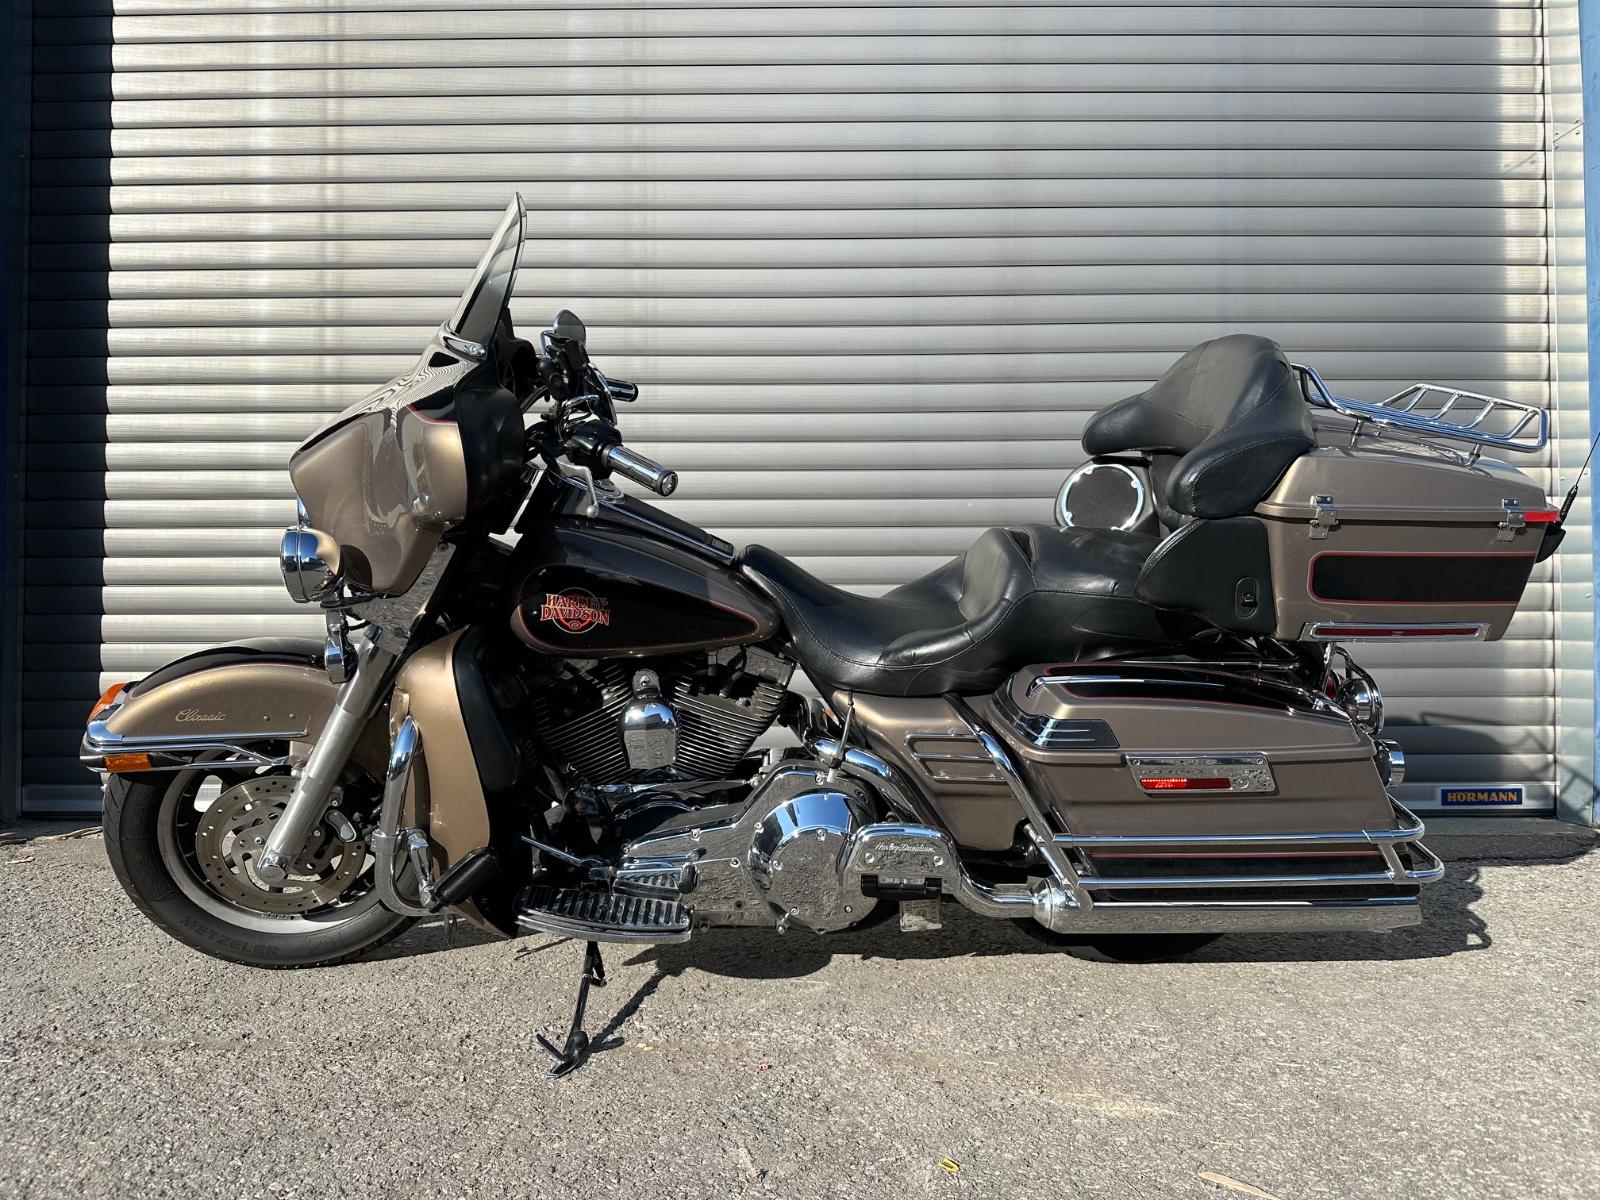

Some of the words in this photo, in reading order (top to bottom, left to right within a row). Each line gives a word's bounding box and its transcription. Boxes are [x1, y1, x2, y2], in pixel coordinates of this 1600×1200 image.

[540, 604, 611, 626] DAVIDSON
[175, 708, 226, 721] Classic
[1447, 791, 1517, 802] HÖRMANN
